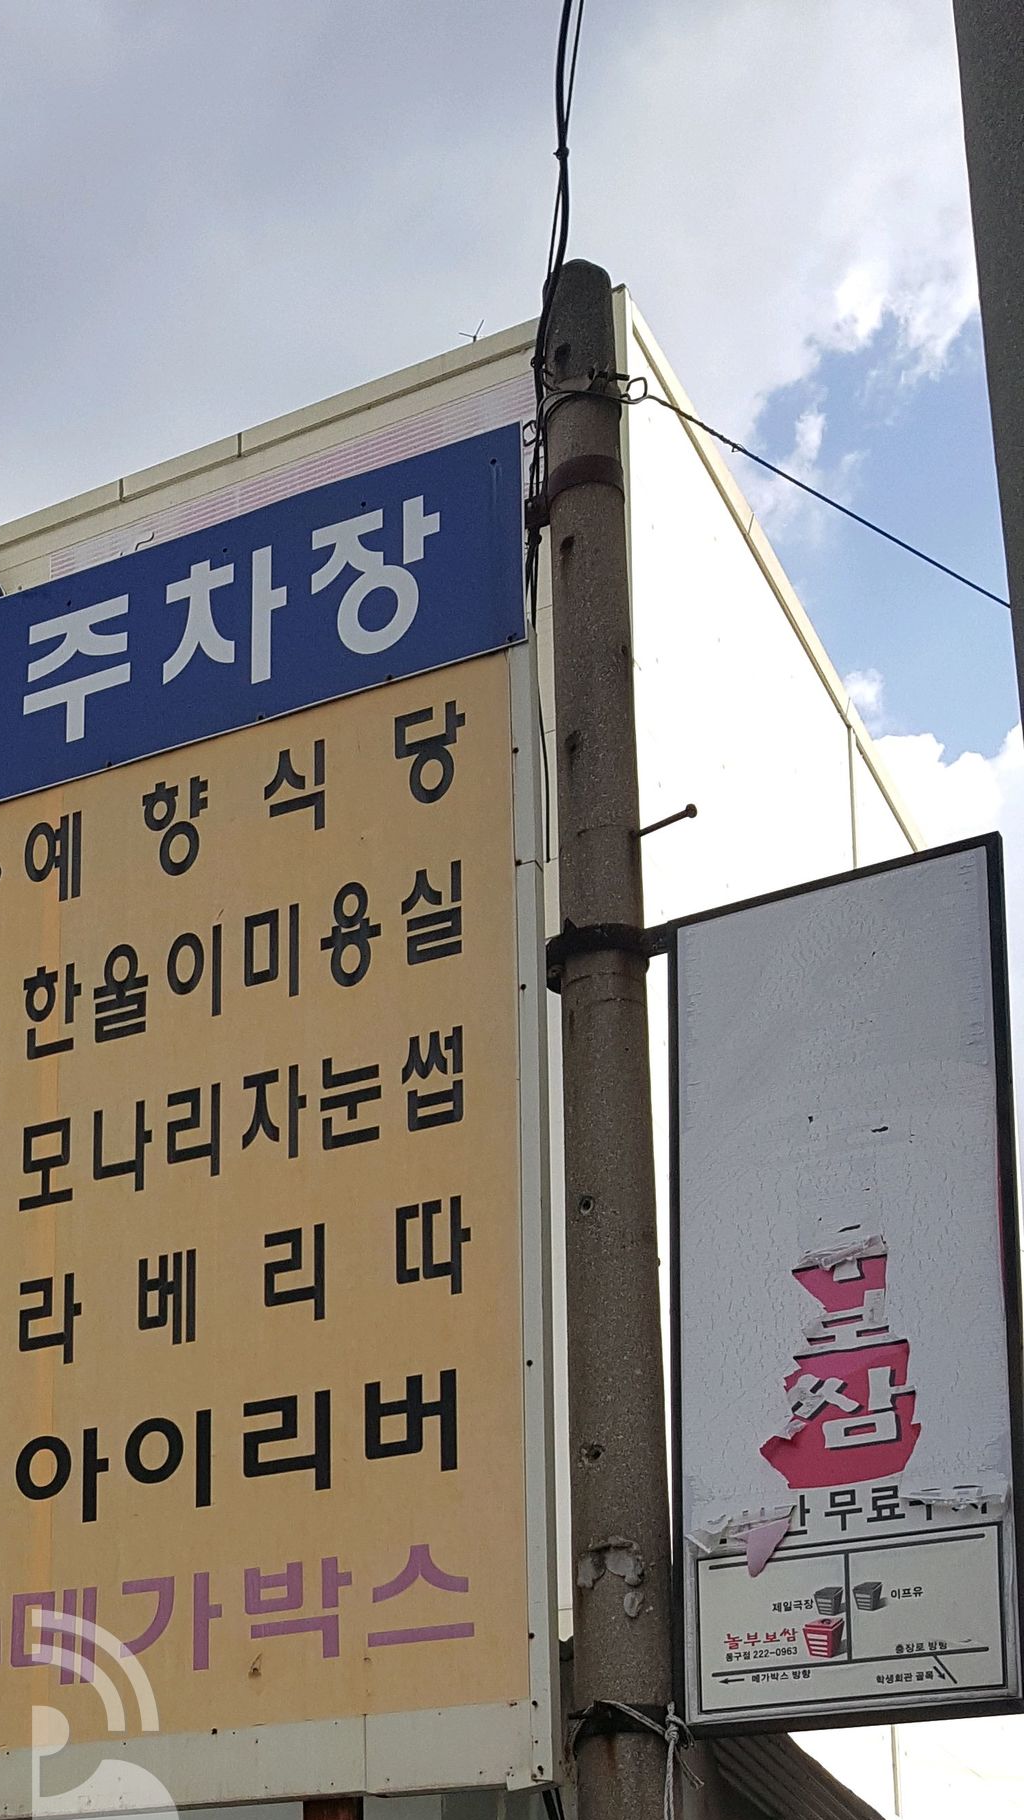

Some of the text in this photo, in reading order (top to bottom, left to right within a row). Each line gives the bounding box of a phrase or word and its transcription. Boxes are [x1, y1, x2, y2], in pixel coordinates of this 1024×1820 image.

[24, 860, 462, 1060] 한울이미용실
[19, 1025, 463, 1211] 모나리자눈썹
[16, 1369, 457, 1522] 아이리버
[10, 1546, 474, 1686] 메가박스
[724, 1628, 798, 1650] 놀부보쌈
[753, 1646, 798, 1659] 222-0963
